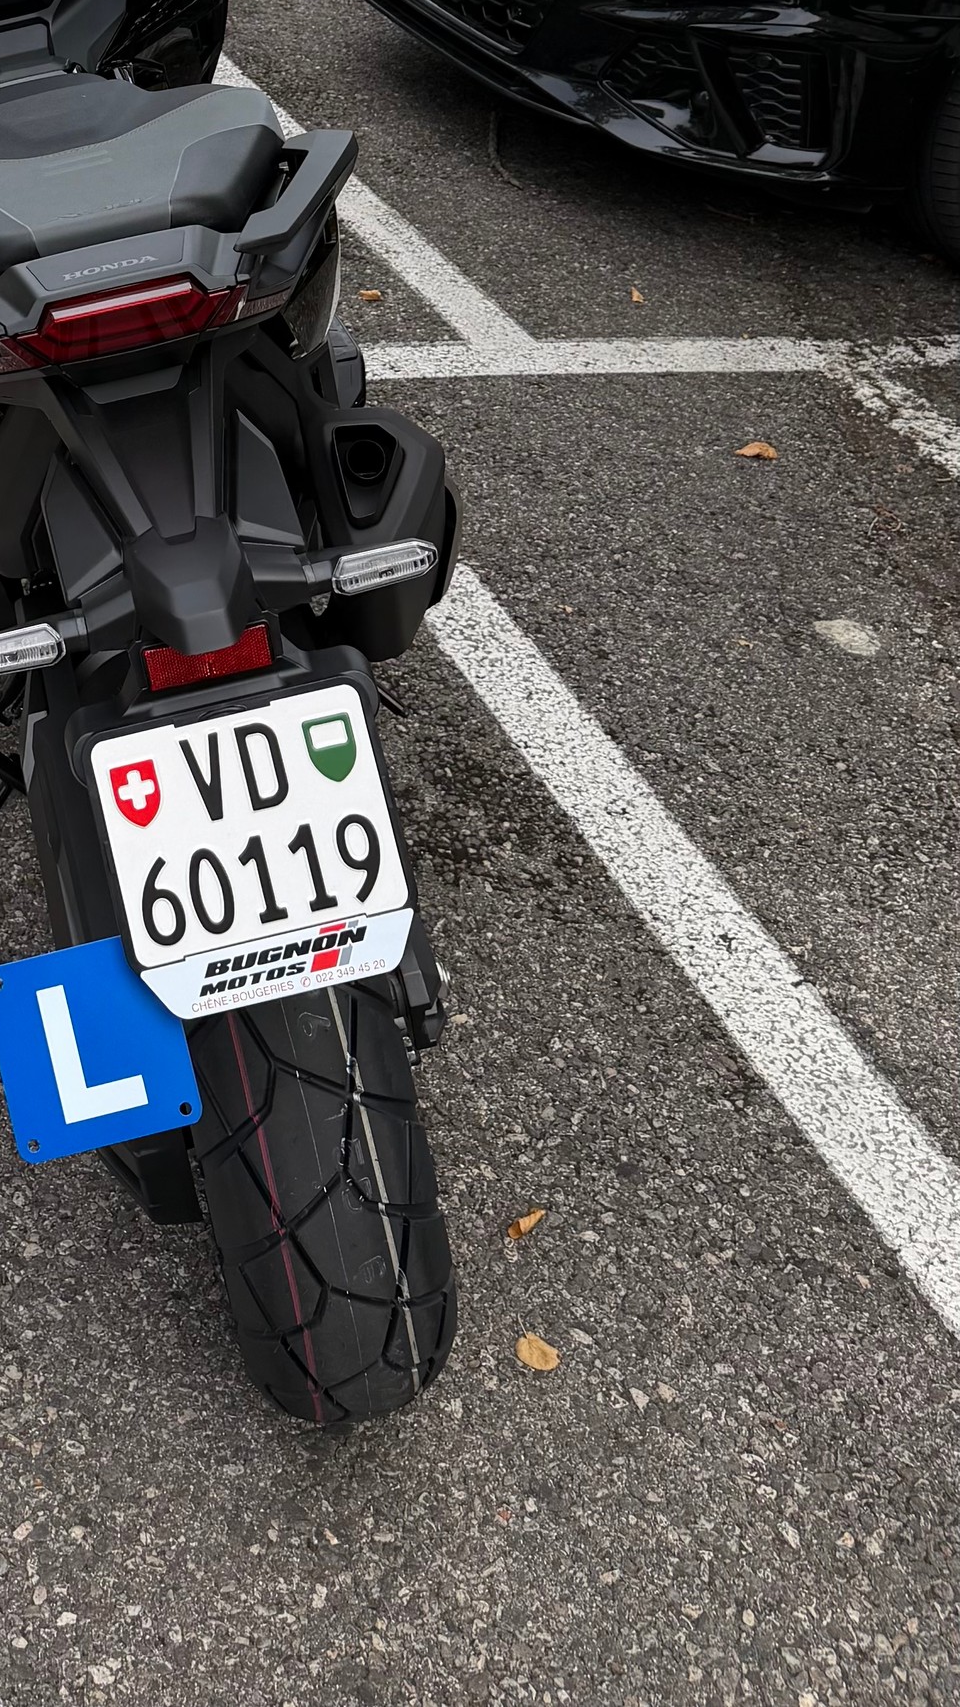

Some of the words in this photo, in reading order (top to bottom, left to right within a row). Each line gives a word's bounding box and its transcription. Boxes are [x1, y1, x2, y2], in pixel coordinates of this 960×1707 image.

[62, 255, 159, 282] HONDA
[178, 722, 289, 821] VD
[141, 813, 381, 946] 60119
[199, 961, 307, 997] MOTOS
[204, 926, 367, 978] BUGNON
[191, 980, 295, 1013] CHÊNE-BOUGERIES
[315, 971, 334, 984] 022
[336, 967, 356, 979] 349
[358, 962, 371, 974] 45
[373, 959, 386, 970] 20
[36, 984, 149, 1125] L
